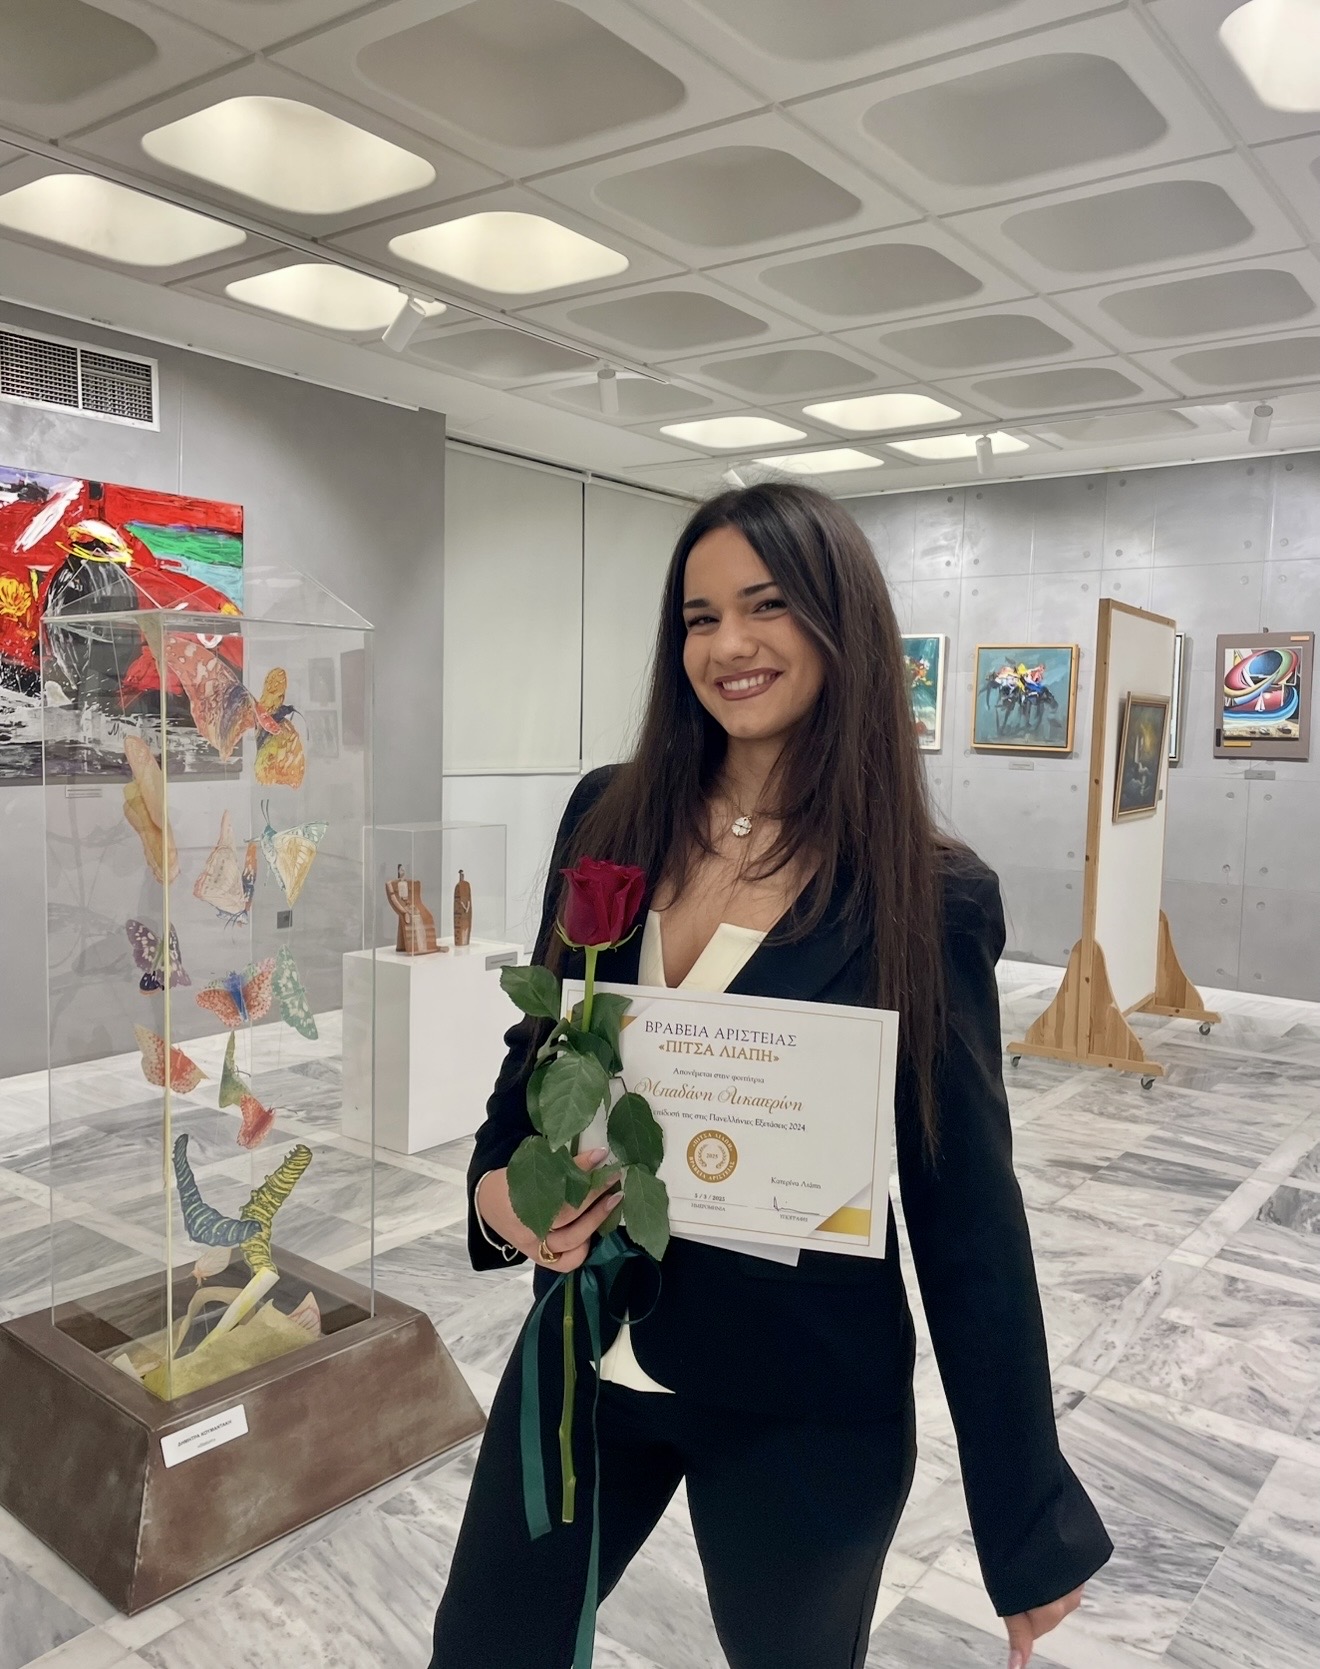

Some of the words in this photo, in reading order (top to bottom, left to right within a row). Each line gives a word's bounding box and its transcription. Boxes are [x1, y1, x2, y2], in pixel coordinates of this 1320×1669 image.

[645, 1020, 709, 1039] ΒΡΑΒΕΙΑ
[714, 1027, 797, 1047] ΑΡΙΣΤΕΙΑΣ
[658, 1040, 715, 1057] «ΠΙΤΣΑ
[719, 1046, 780, 1063] ΛΙΑΠΗ»
[673, 1067, 712, 1078] Απονέμεται
[714, 1072, 730, 1080] στην
[732, 1074, 765, 1084] φοιτήτρια
[634, 1077, 713, 1101] Μπαδάνη
[717, 1085, 803, 1114] Αικατερίνη
[682, 1111, 693, 1120] της
[694, 1113, 707, 1121] στις
[709, 1113, 754, 1126] Πανελλήνιες
[755, 1118, 788, 1130] Εξετάσεις
[789, 1122, 806, 1131] 2024
[706, 1152, 719, 1160] 2025
[771, 1176, 799, 1186] Κατερίνα
